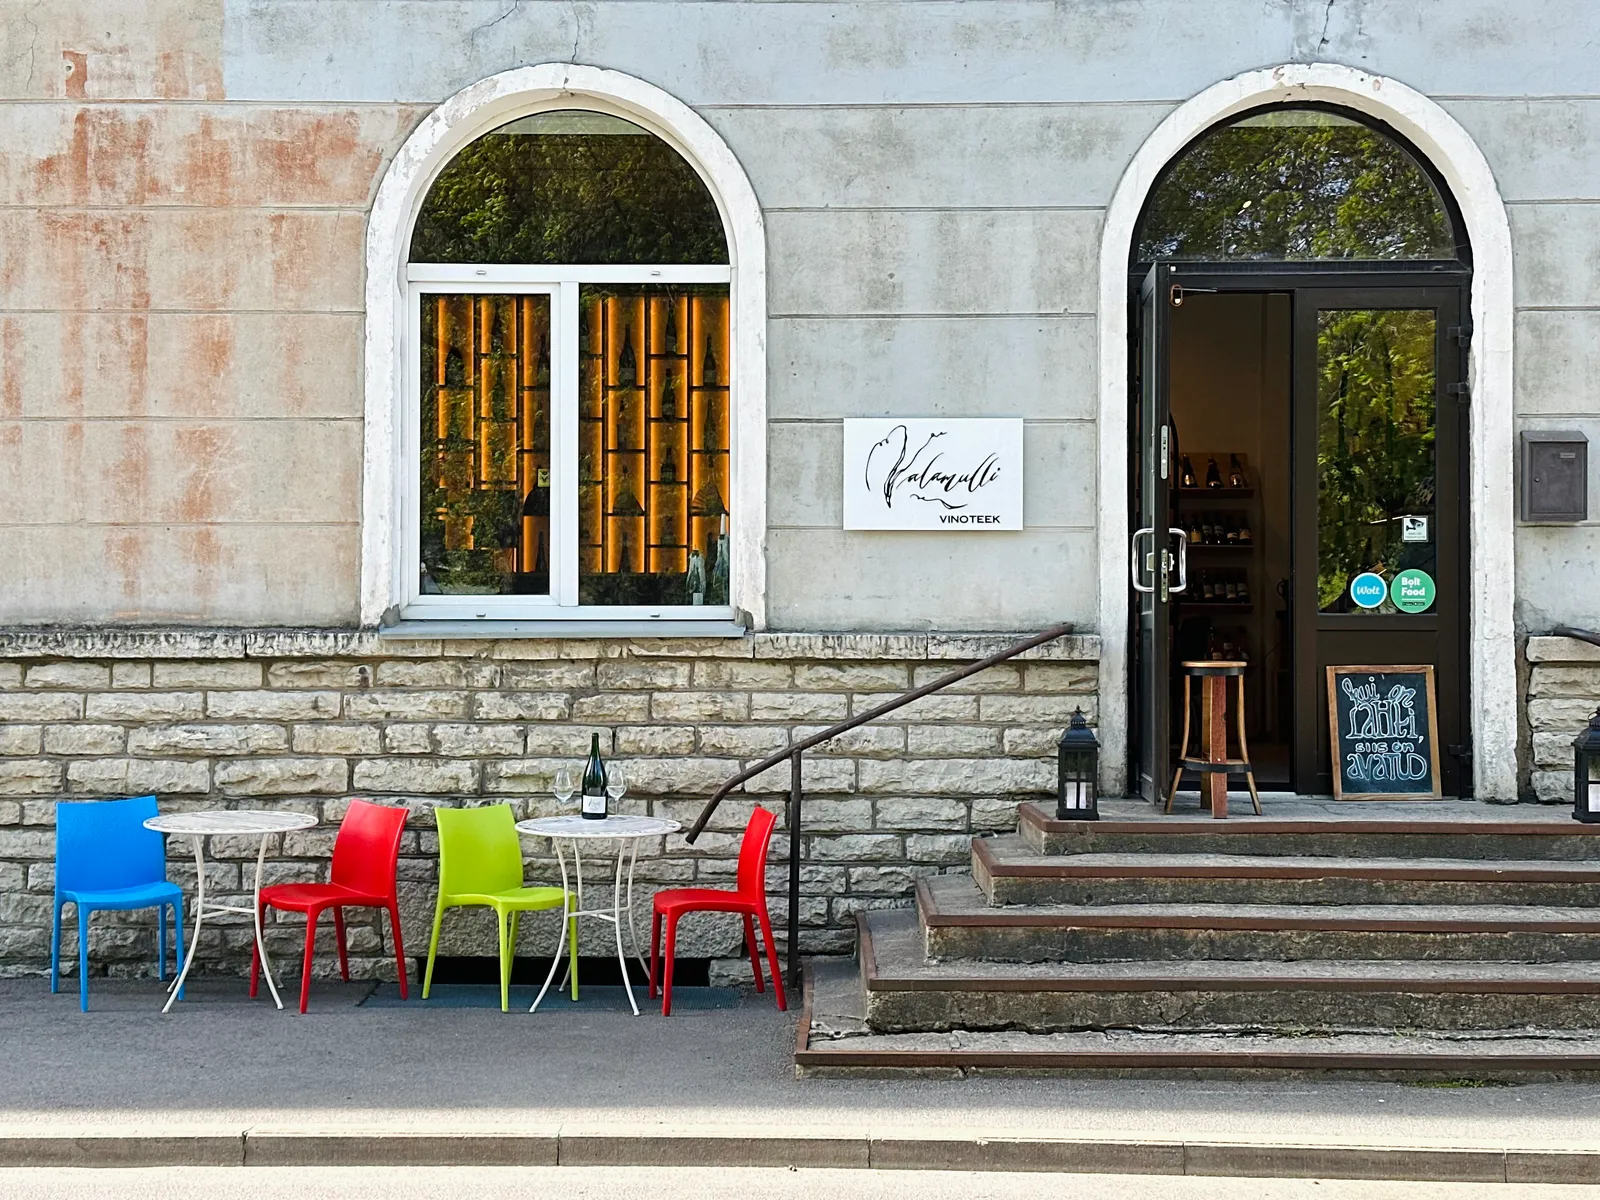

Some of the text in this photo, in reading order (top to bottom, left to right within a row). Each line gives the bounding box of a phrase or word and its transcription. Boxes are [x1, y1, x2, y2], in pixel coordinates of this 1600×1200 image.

[939, 515, 1001, 524] VINOTEEK
[1401, 577, 1420, 587] Bolt
[1357, 586, 1380, 595] Wolt
[1401, 587, 1425, 596] Food
